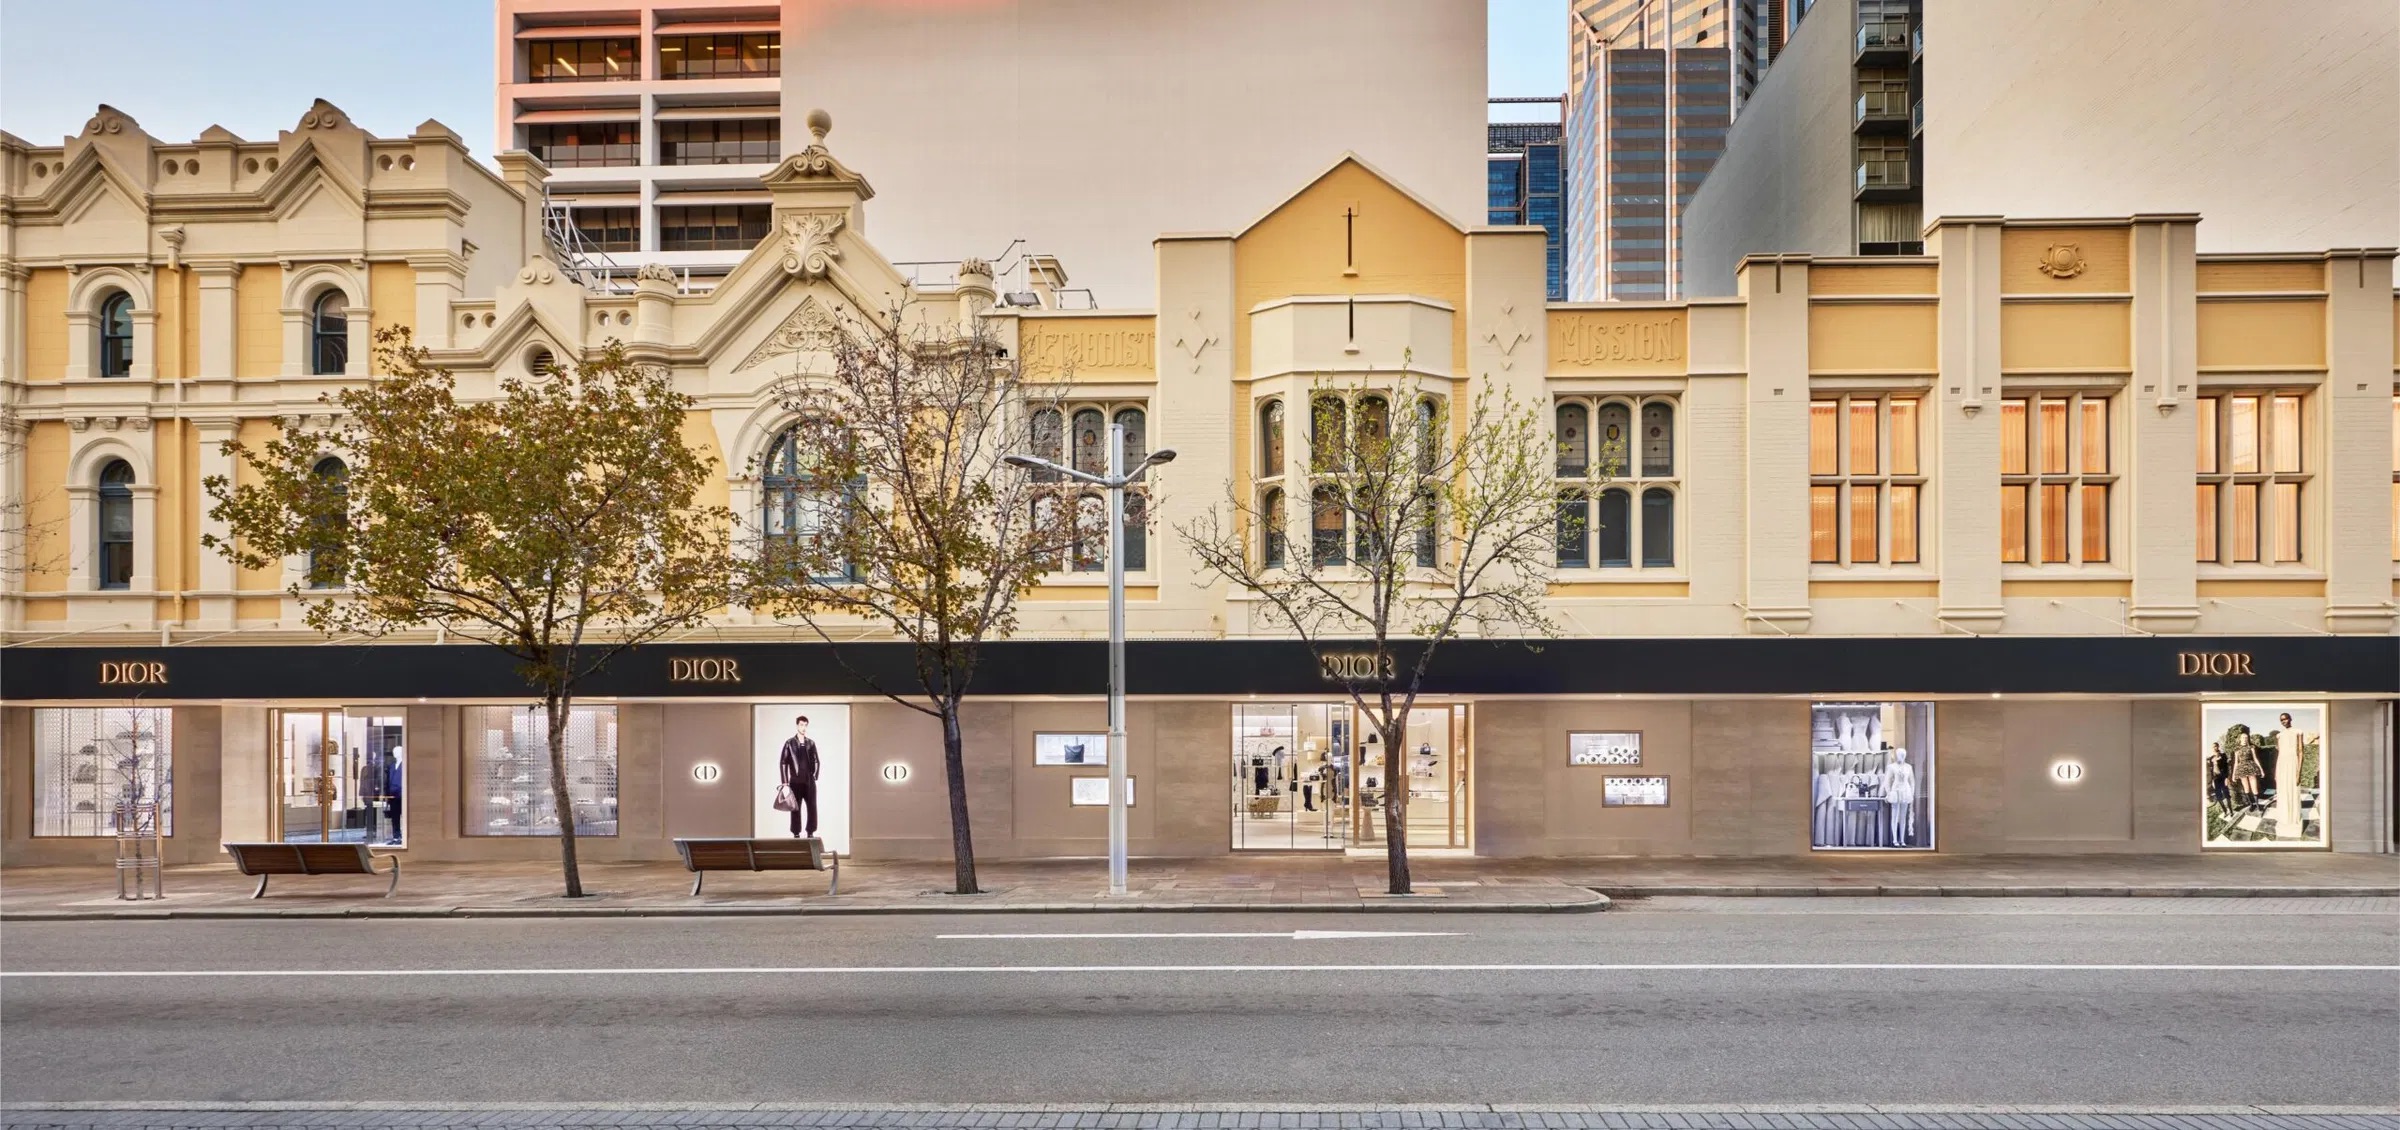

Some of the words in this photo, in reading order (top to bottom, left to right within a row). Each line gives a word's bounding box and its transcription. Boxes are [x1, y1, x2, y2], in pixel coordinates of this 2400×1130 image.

[99, 662, 168, 684] DIOR
[670, 659, 741, 681] DIOR
[2178, 653, 2256, 676] DIOR
